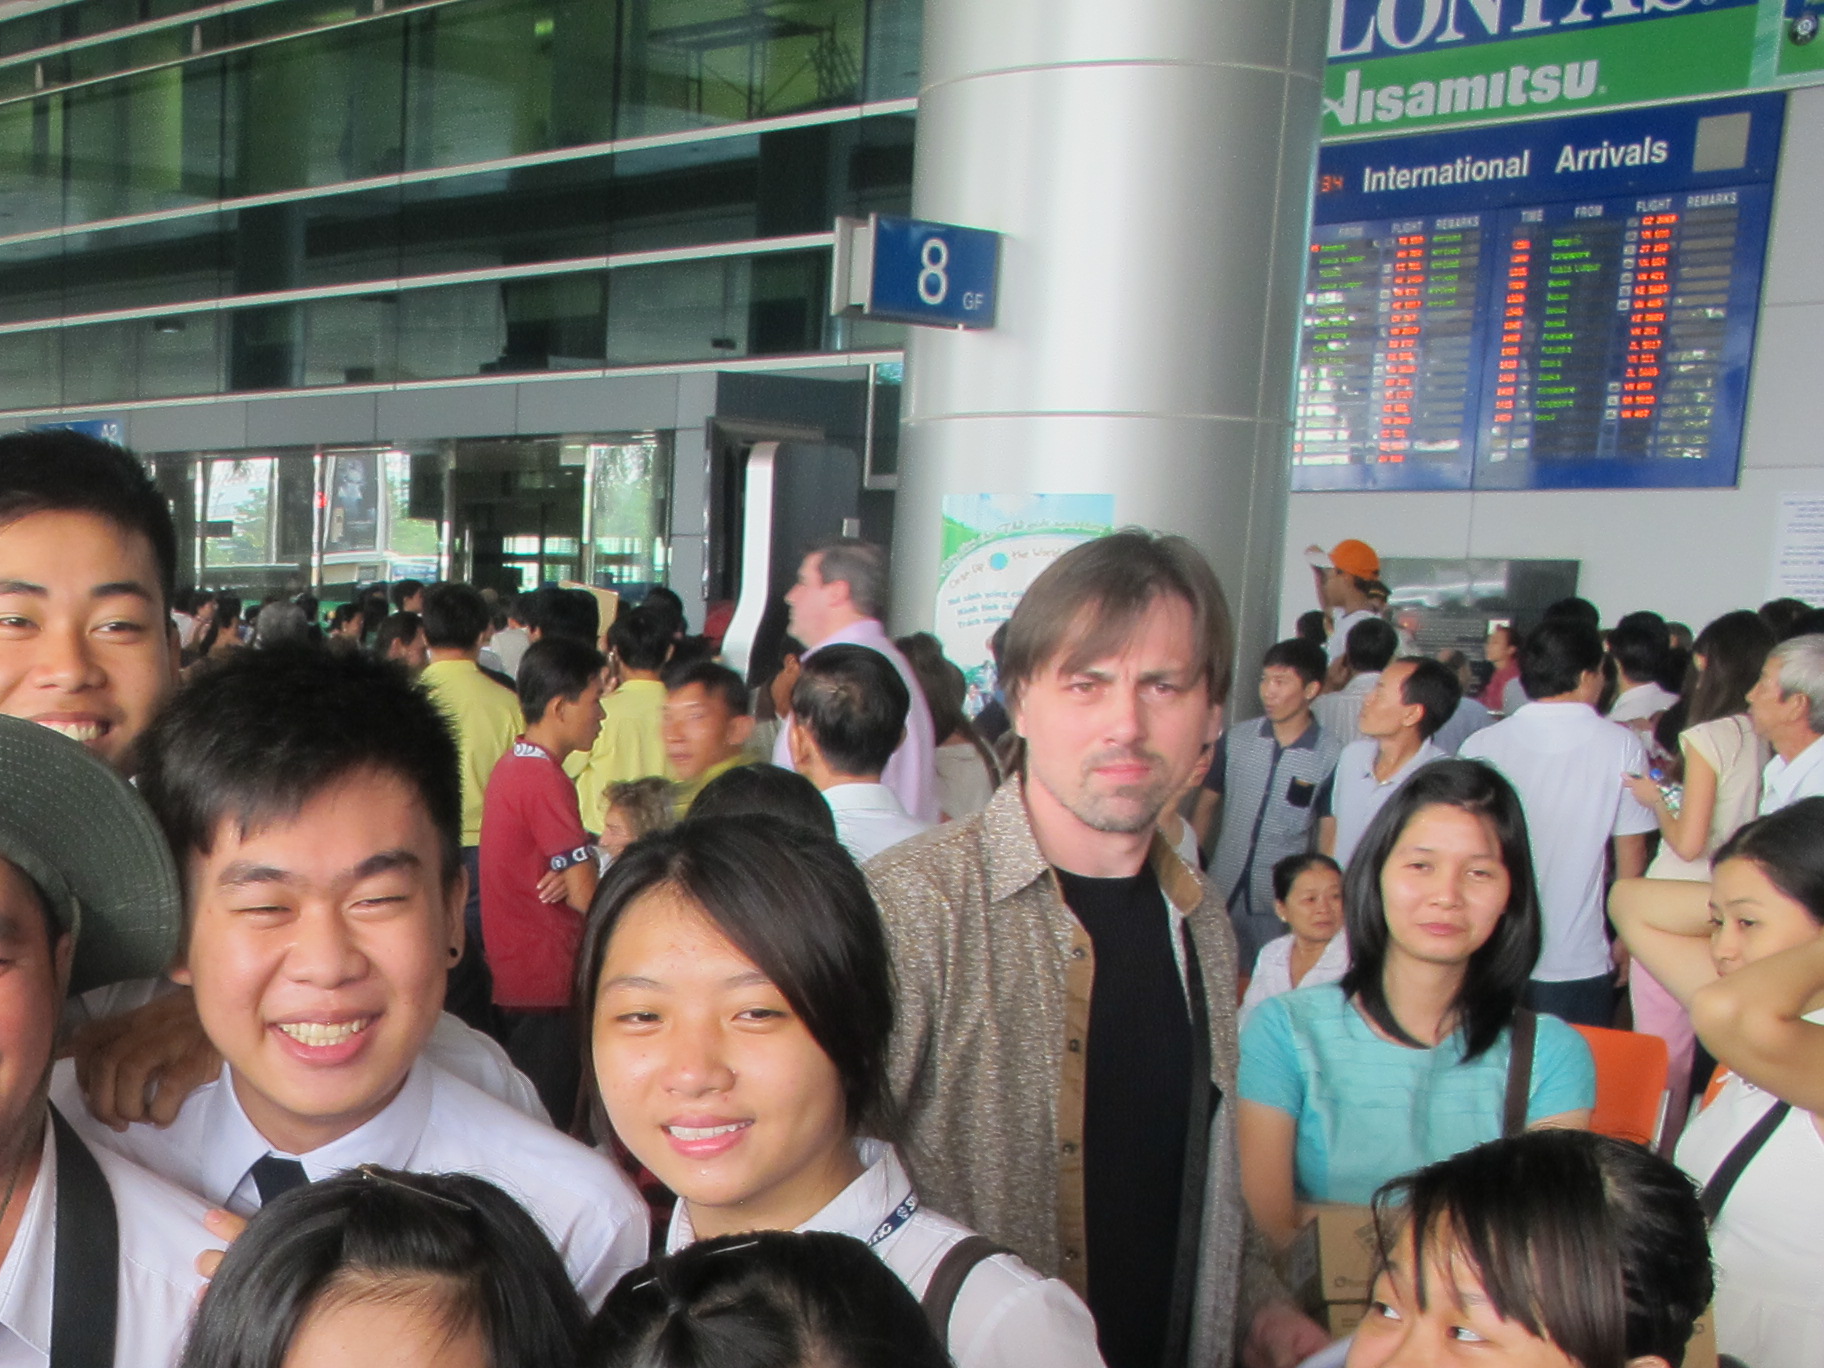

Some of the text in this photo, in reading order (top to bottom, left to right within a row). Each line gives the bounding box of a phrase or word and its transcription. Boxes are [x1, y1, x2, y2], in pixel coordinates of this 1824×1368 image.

[1328, 0, 1683, 58] LON
[1362, 136, 1669, 193] International Arrivals
[1575, 205, 1603, 218] FROM
[1636, 198, 1672, 212] FLIGHT
[1686, 192, 1737, 208] REMARKS
[1435, 215, 1480, 230] REMARKS
[918, 238, 949, 305] 8
[963, 291, 984, 310] GF
